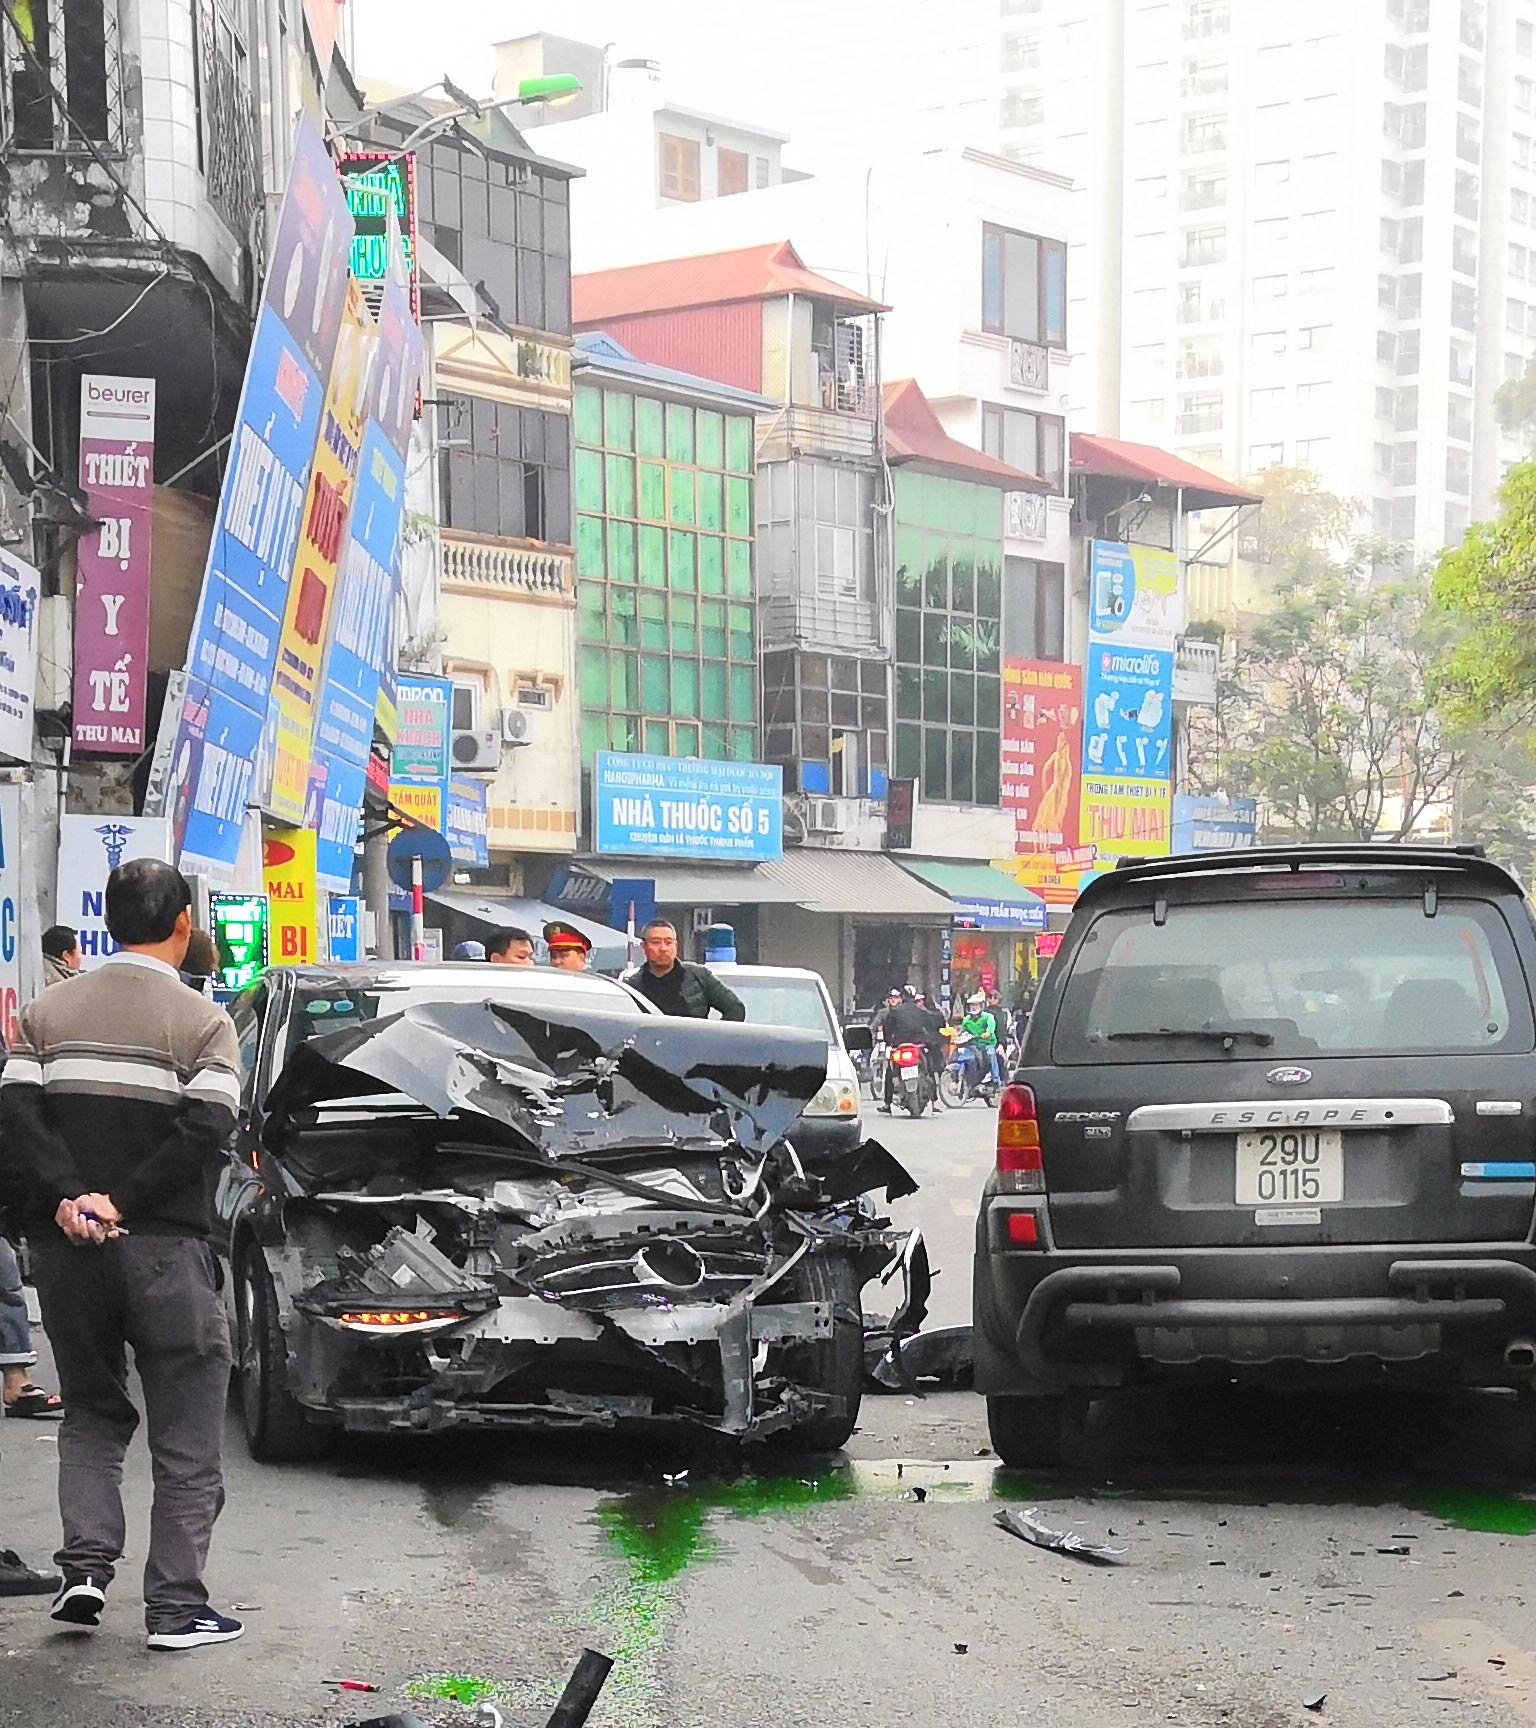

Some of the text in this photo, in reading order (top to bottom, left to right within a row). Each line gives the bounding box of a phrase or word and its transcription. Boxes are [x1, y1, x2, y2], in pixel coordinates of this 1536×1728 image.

[88, 381, 151, 405] beurer
[84, 443, 150, 490] THIẾT
[98, 517, 132, 574] BỊ
[99, 593, 126, 637] Y
[1112, 653, 1160, 676] microlife
[89, 655, 132, 713] TẾ
[76, 723, 142, 745] THU MAI
[660, 791, 722, 832] THUỐC
[728, 797, 754, 834] SỐ
[758, 808, 770, 836] 5
[1087, 804, 1127, 840] THU
[1131, 806, 1167, 842] MAI
[268, 882, 304, 898] MAI
[1211, 1109, 1368, 1125] ESCAPE
[1259, 1134, 1321, 1167] 29U
[1258, 1168, 1321, 1201] 0115
